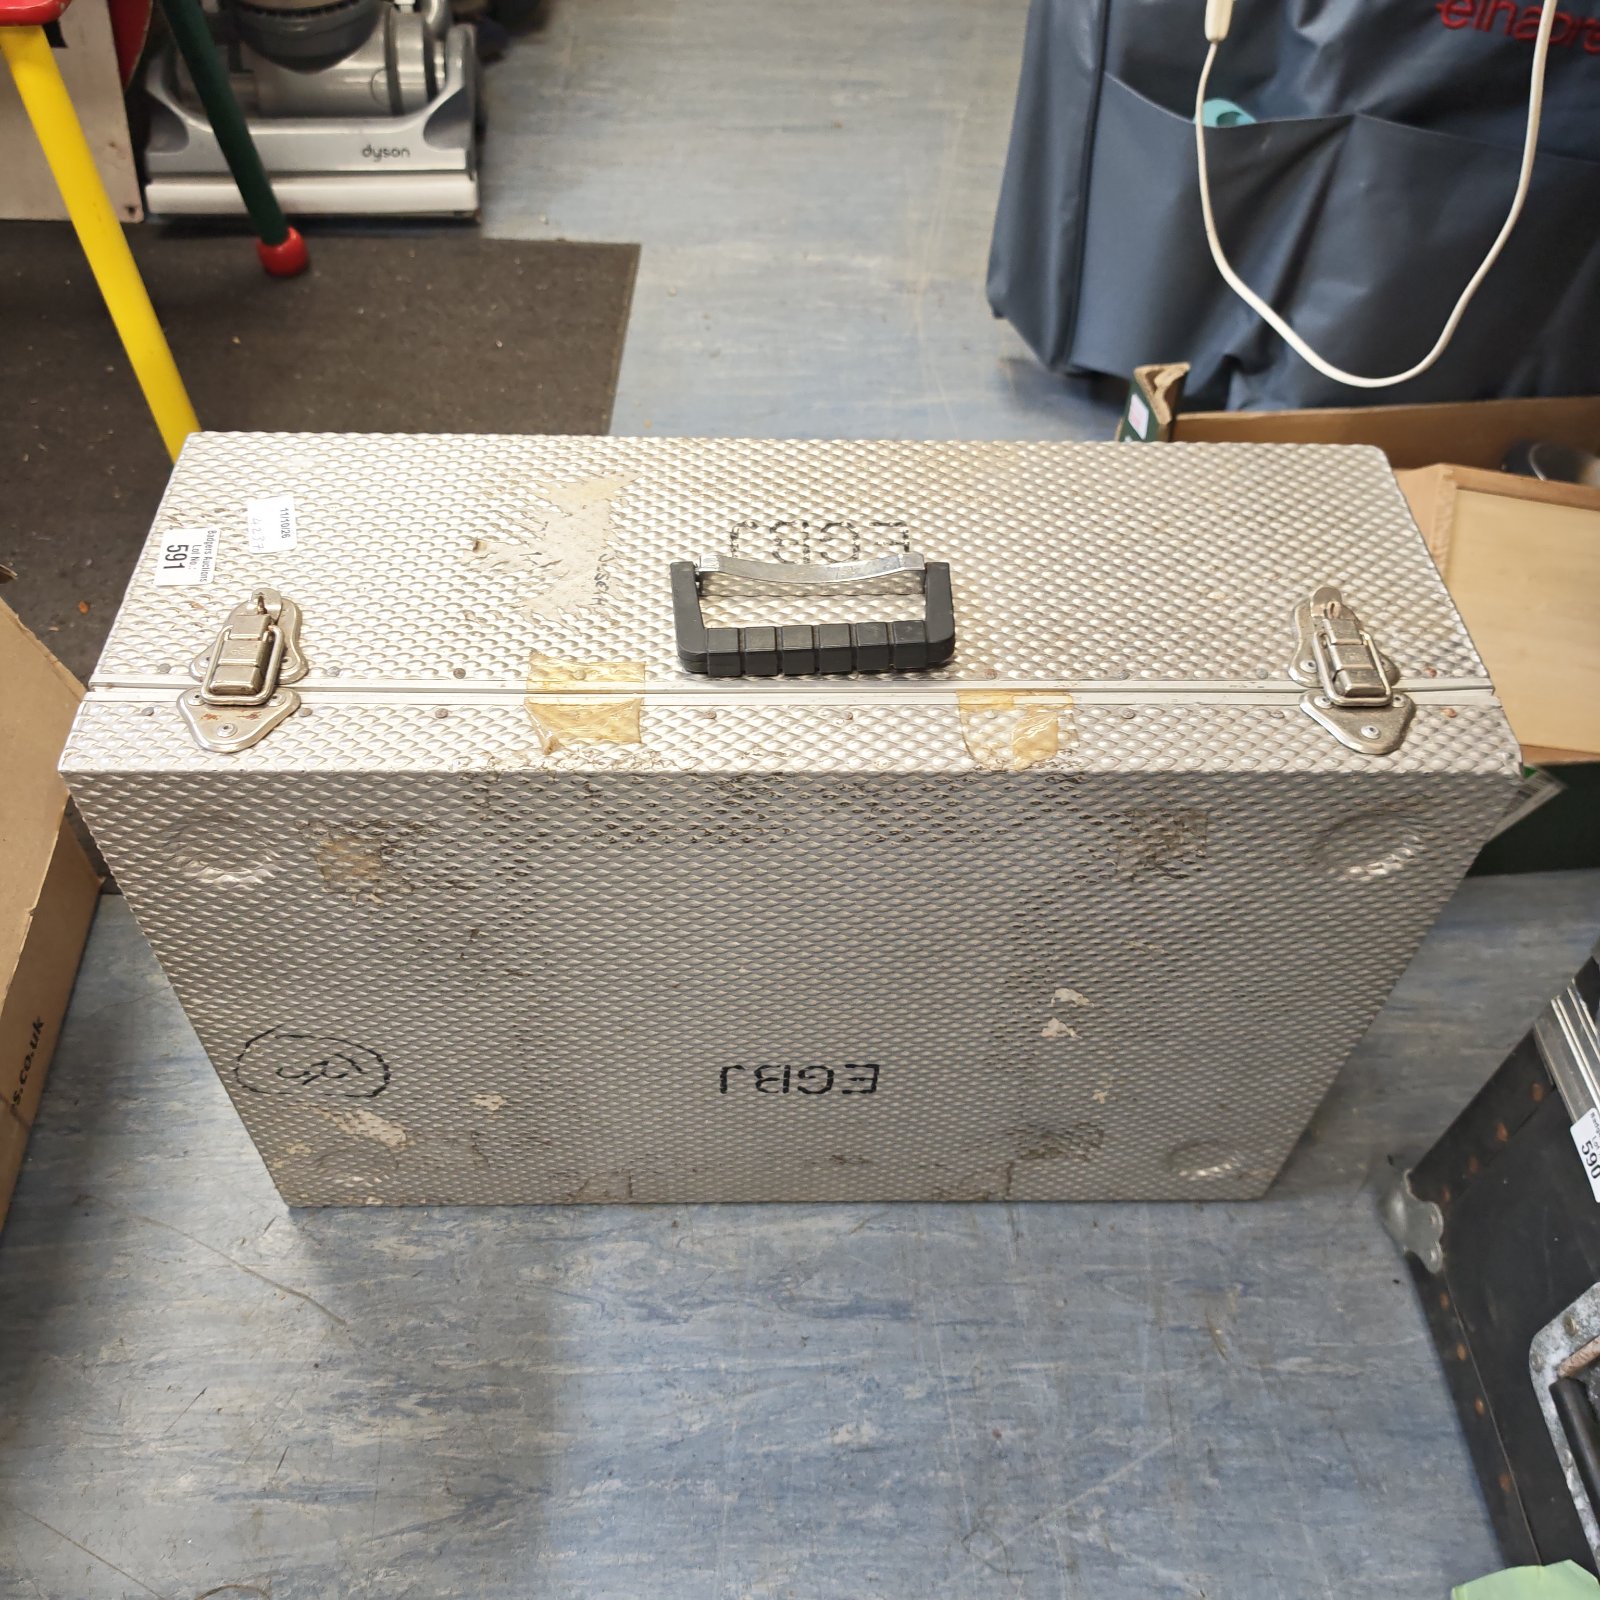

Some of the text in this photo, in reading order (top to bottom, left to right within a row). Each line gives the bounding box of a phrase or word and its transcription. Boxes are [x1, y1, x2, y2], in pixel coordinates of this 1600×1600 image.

[362, 144, 410, 163] dyson
[163, 544, 189, 570] 591
[191, 544, 202, 555] Lot
[199, 530, 218, 583] Badgers Auctions
[1581, 1140, 1600, 1180] 590
